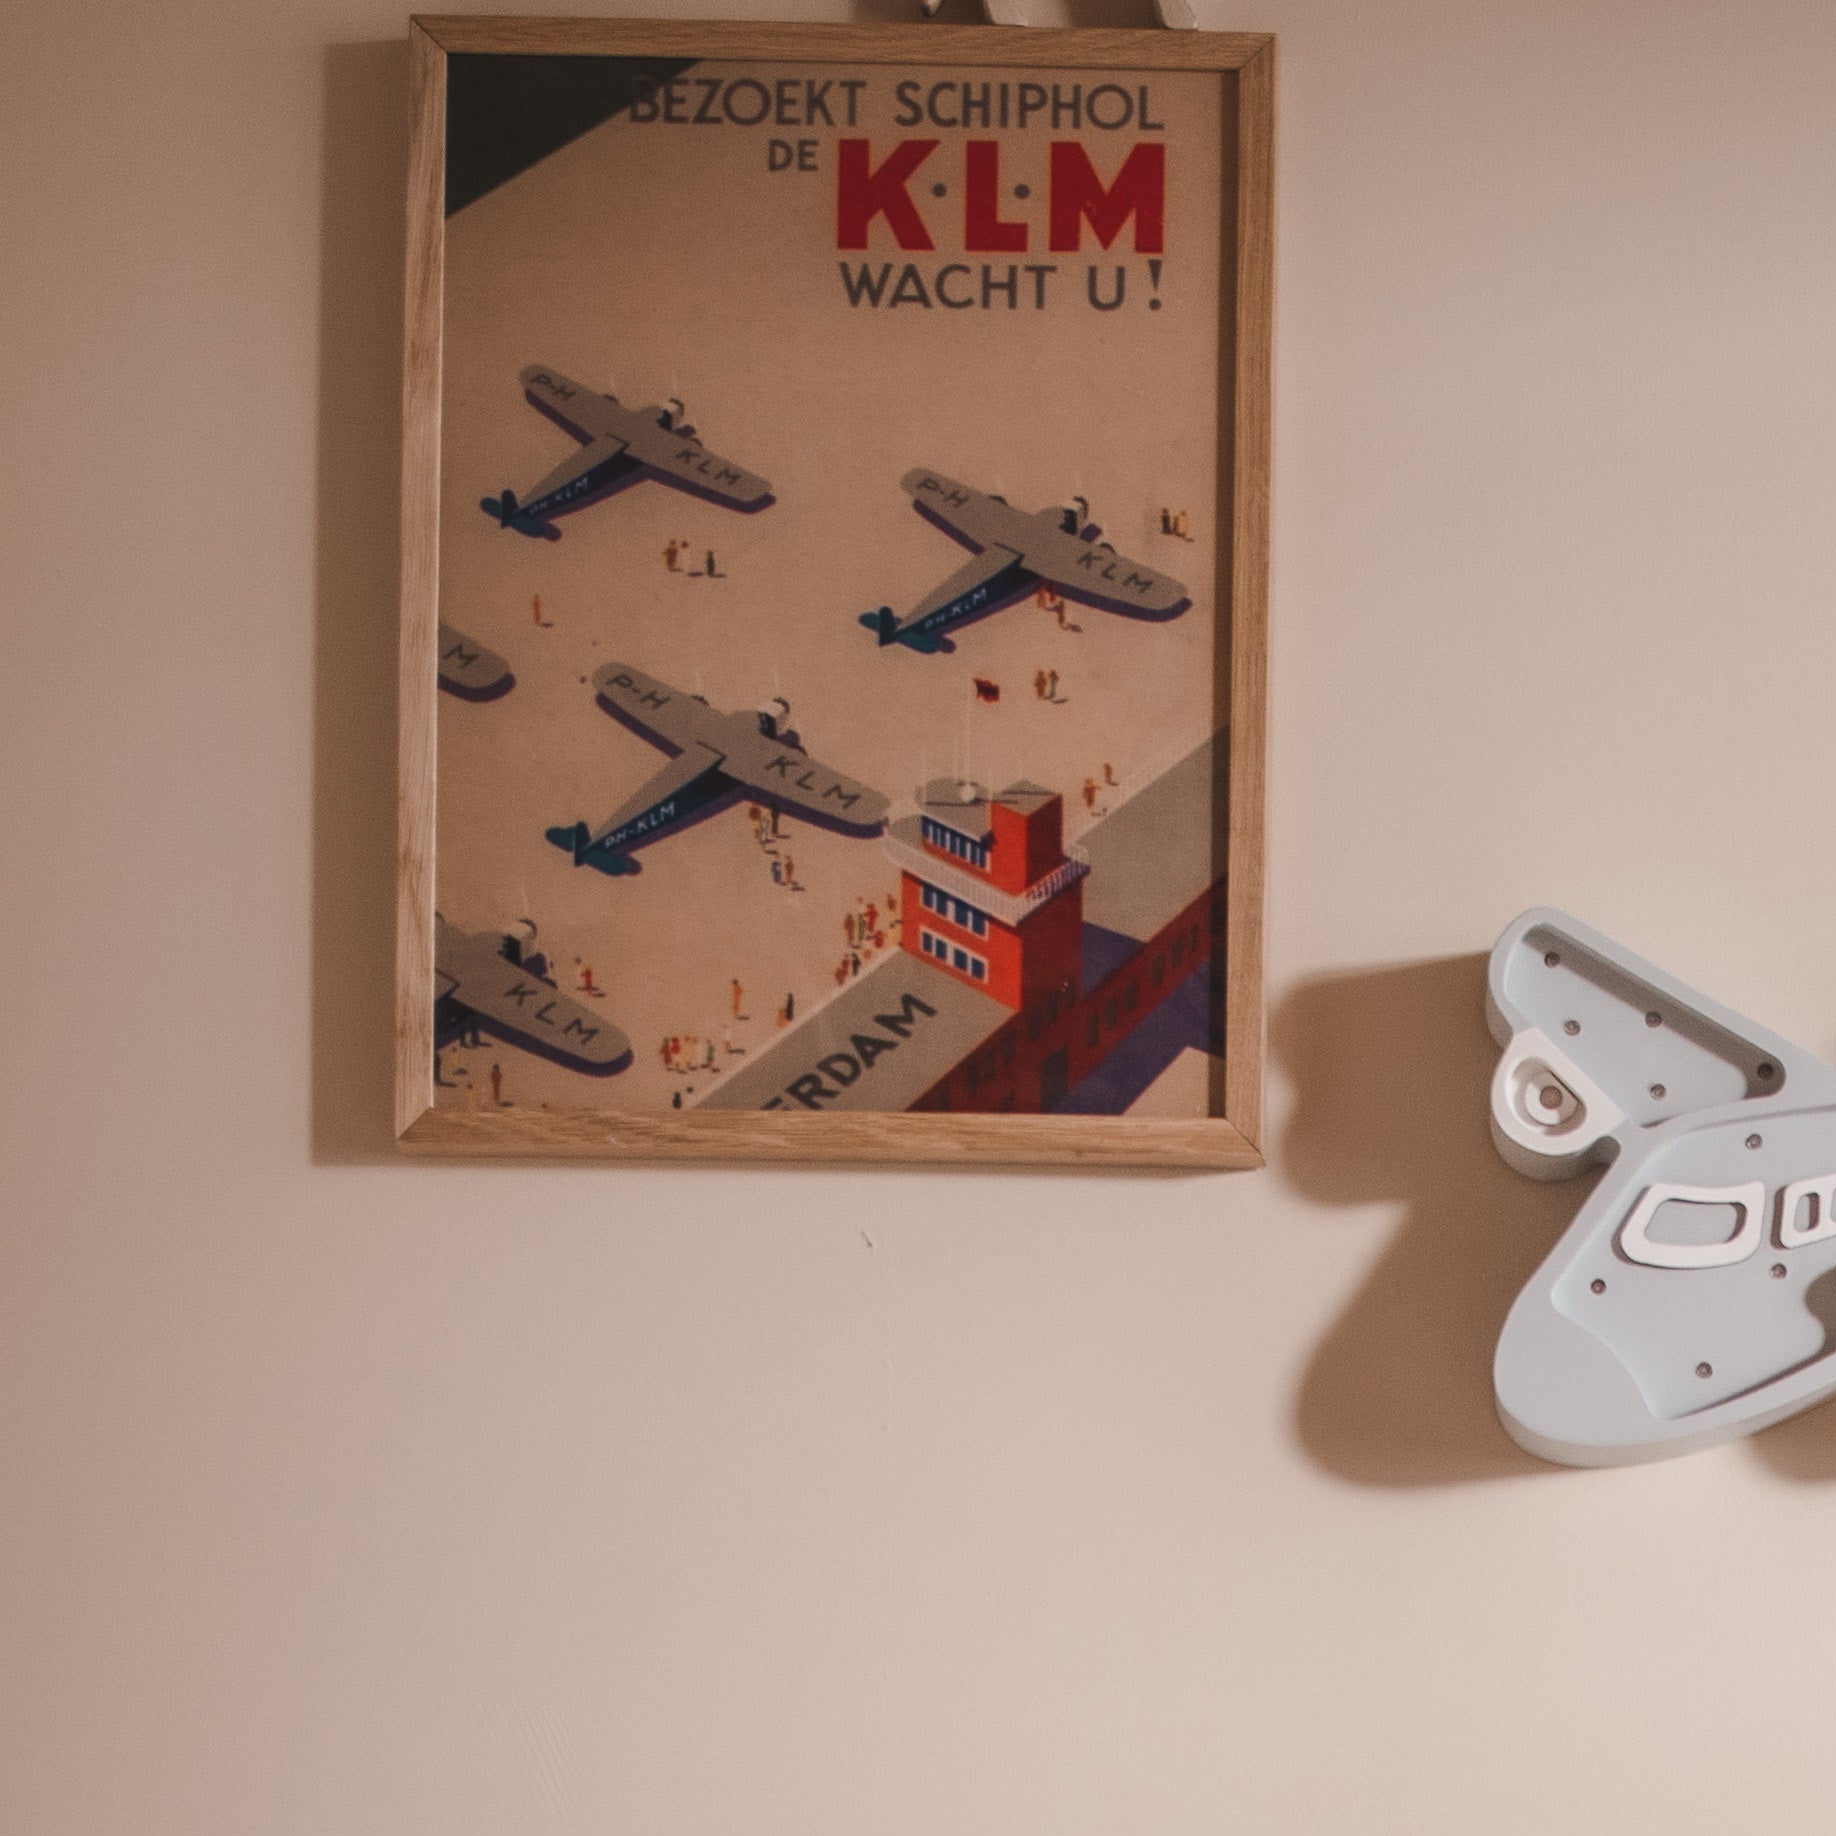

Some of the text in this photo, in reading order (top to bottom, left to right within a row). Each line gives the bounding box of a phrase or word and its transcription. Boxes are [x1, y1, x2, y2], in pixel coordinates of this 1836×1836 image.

[628, 78, 1166, 131] BEZOEKT SCHIPHOL
[768, 138, 819, 173] DE
[838, 260, 1058, 311] WACHT
[674, 449, 742, 487] KLM
[1077, 550, 1154, 595] KLM
[764, 754, 862, 810] KLM
[504, 981, 600, 1046] KLM
